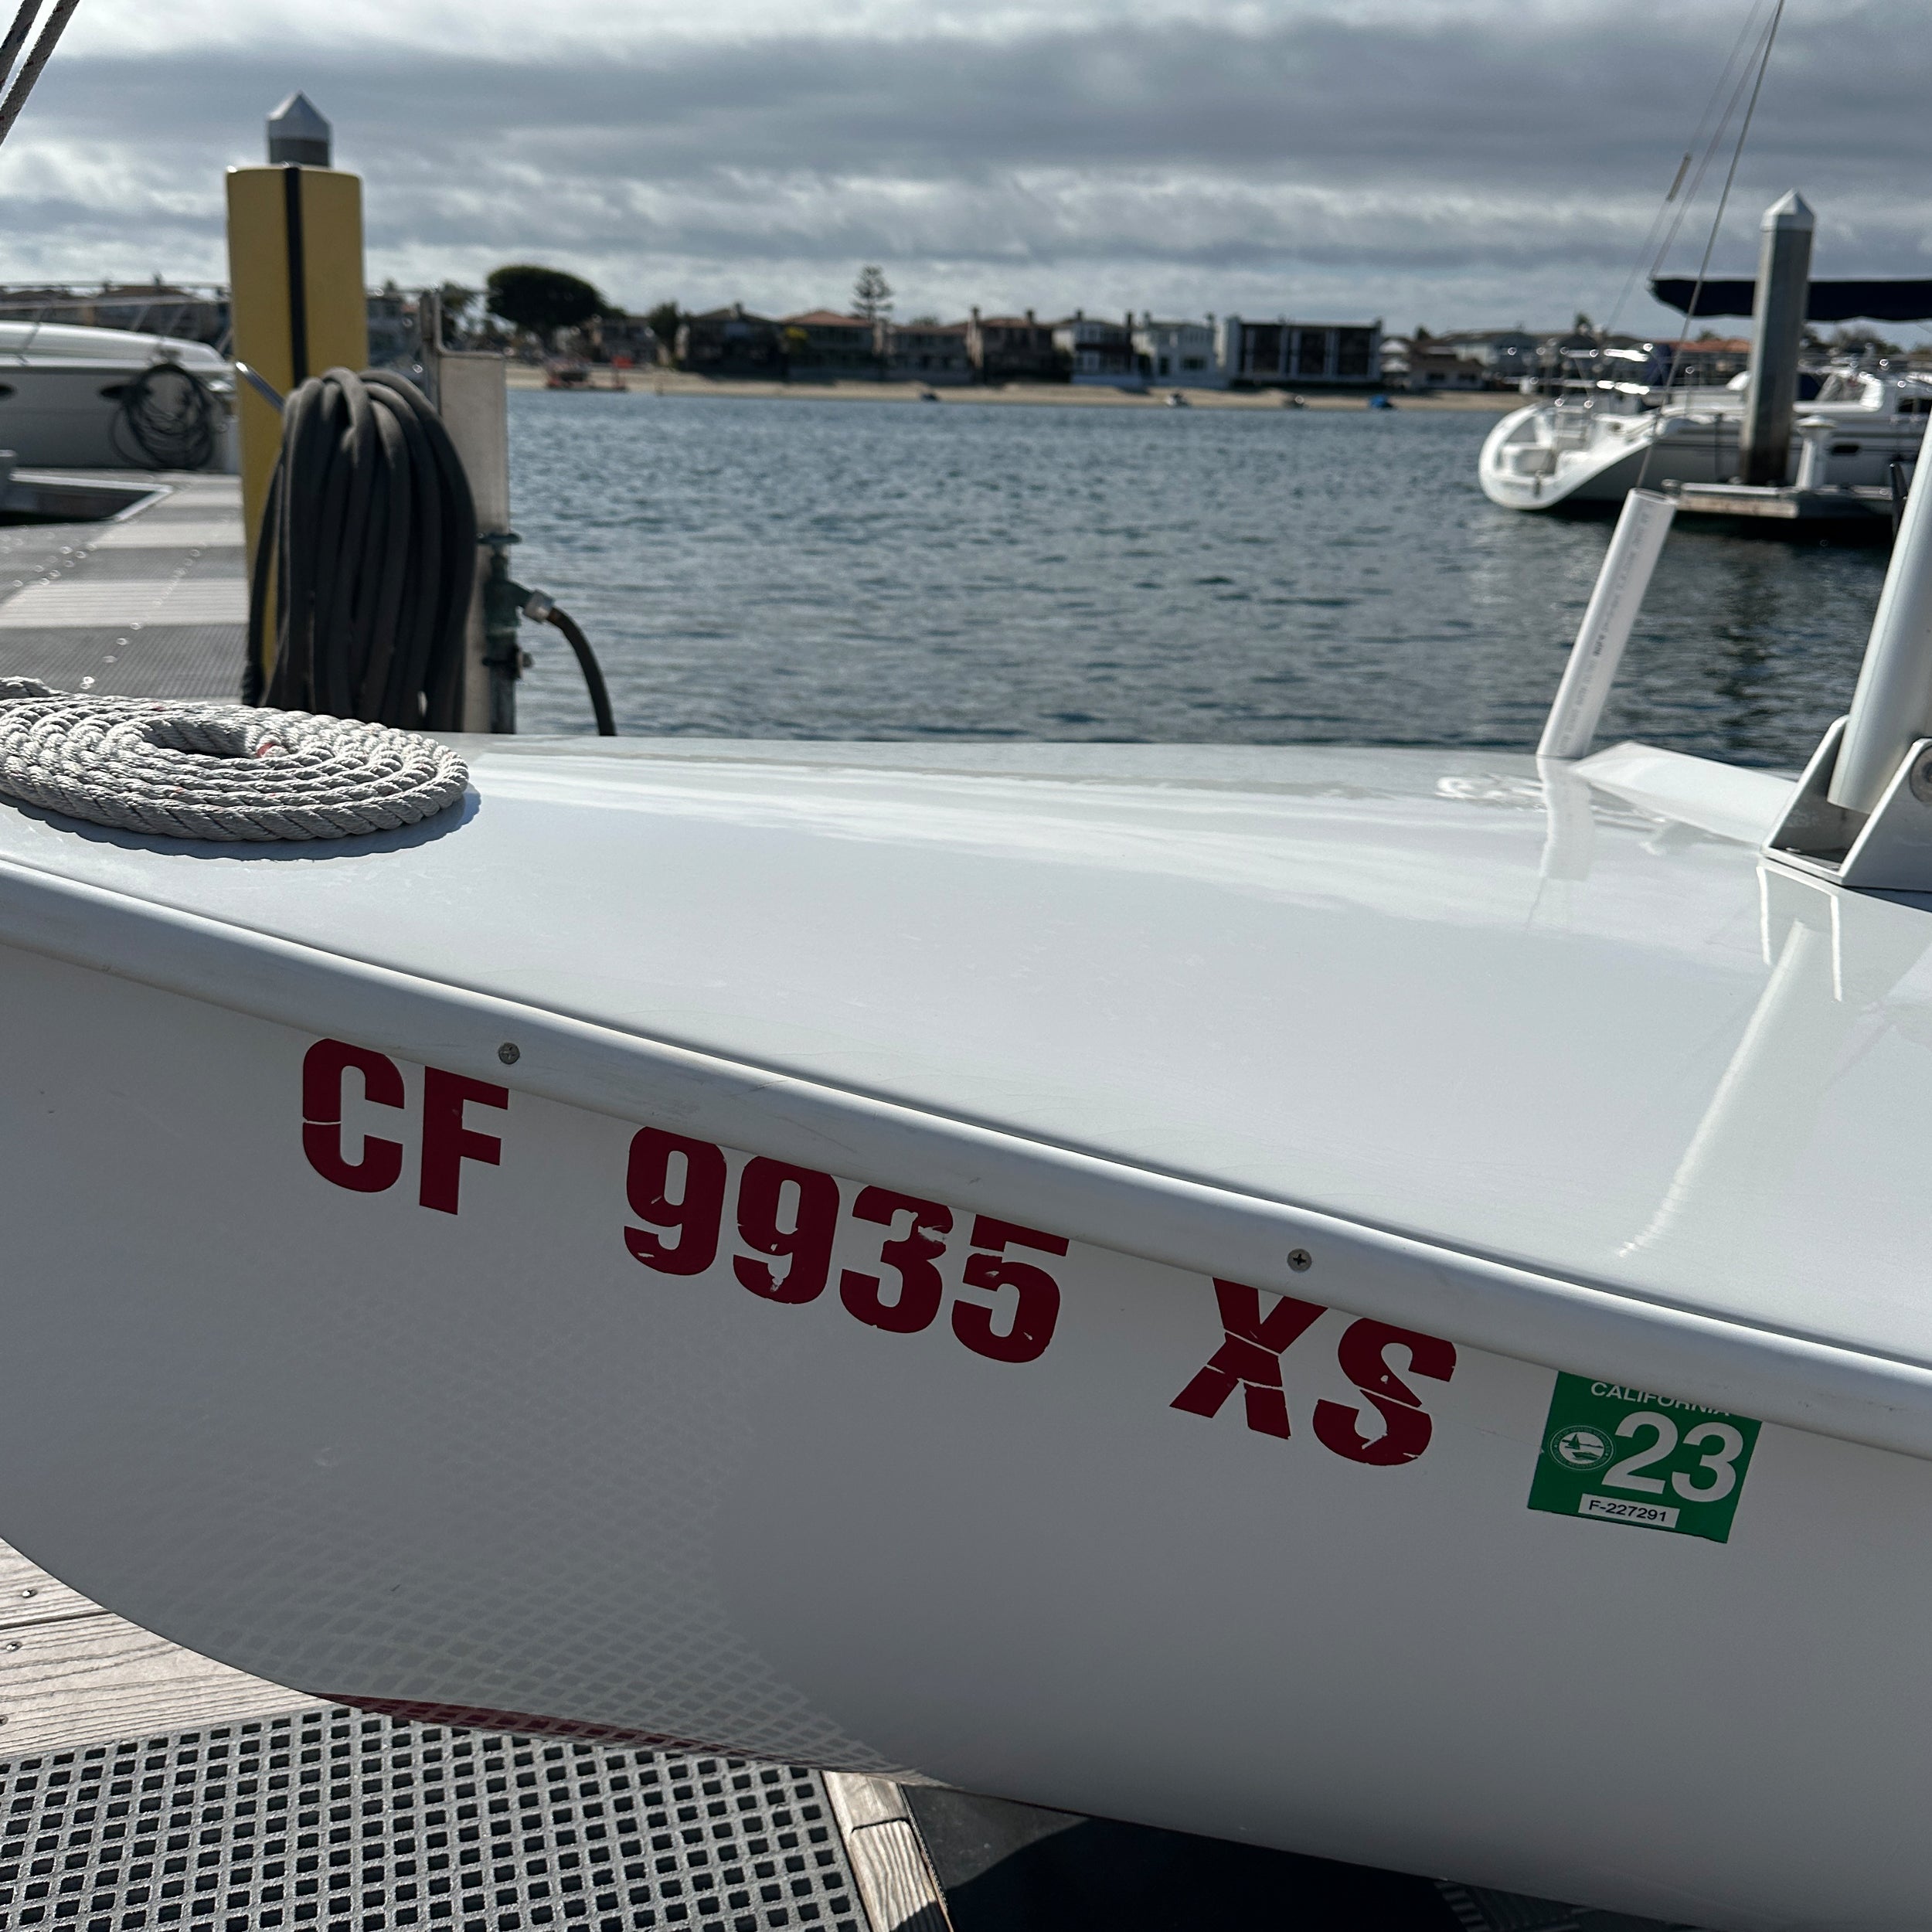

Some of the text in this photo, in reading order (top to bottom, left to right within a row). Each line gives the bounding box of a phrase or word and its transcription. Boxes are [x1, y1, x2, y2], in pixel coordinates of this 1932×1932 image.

[302, 1038, 1457, 1465] CF 9935 XS
[1601, 1411, 1743, 1502] 23
[1589, 1500, 1666, 1522] F-227291
